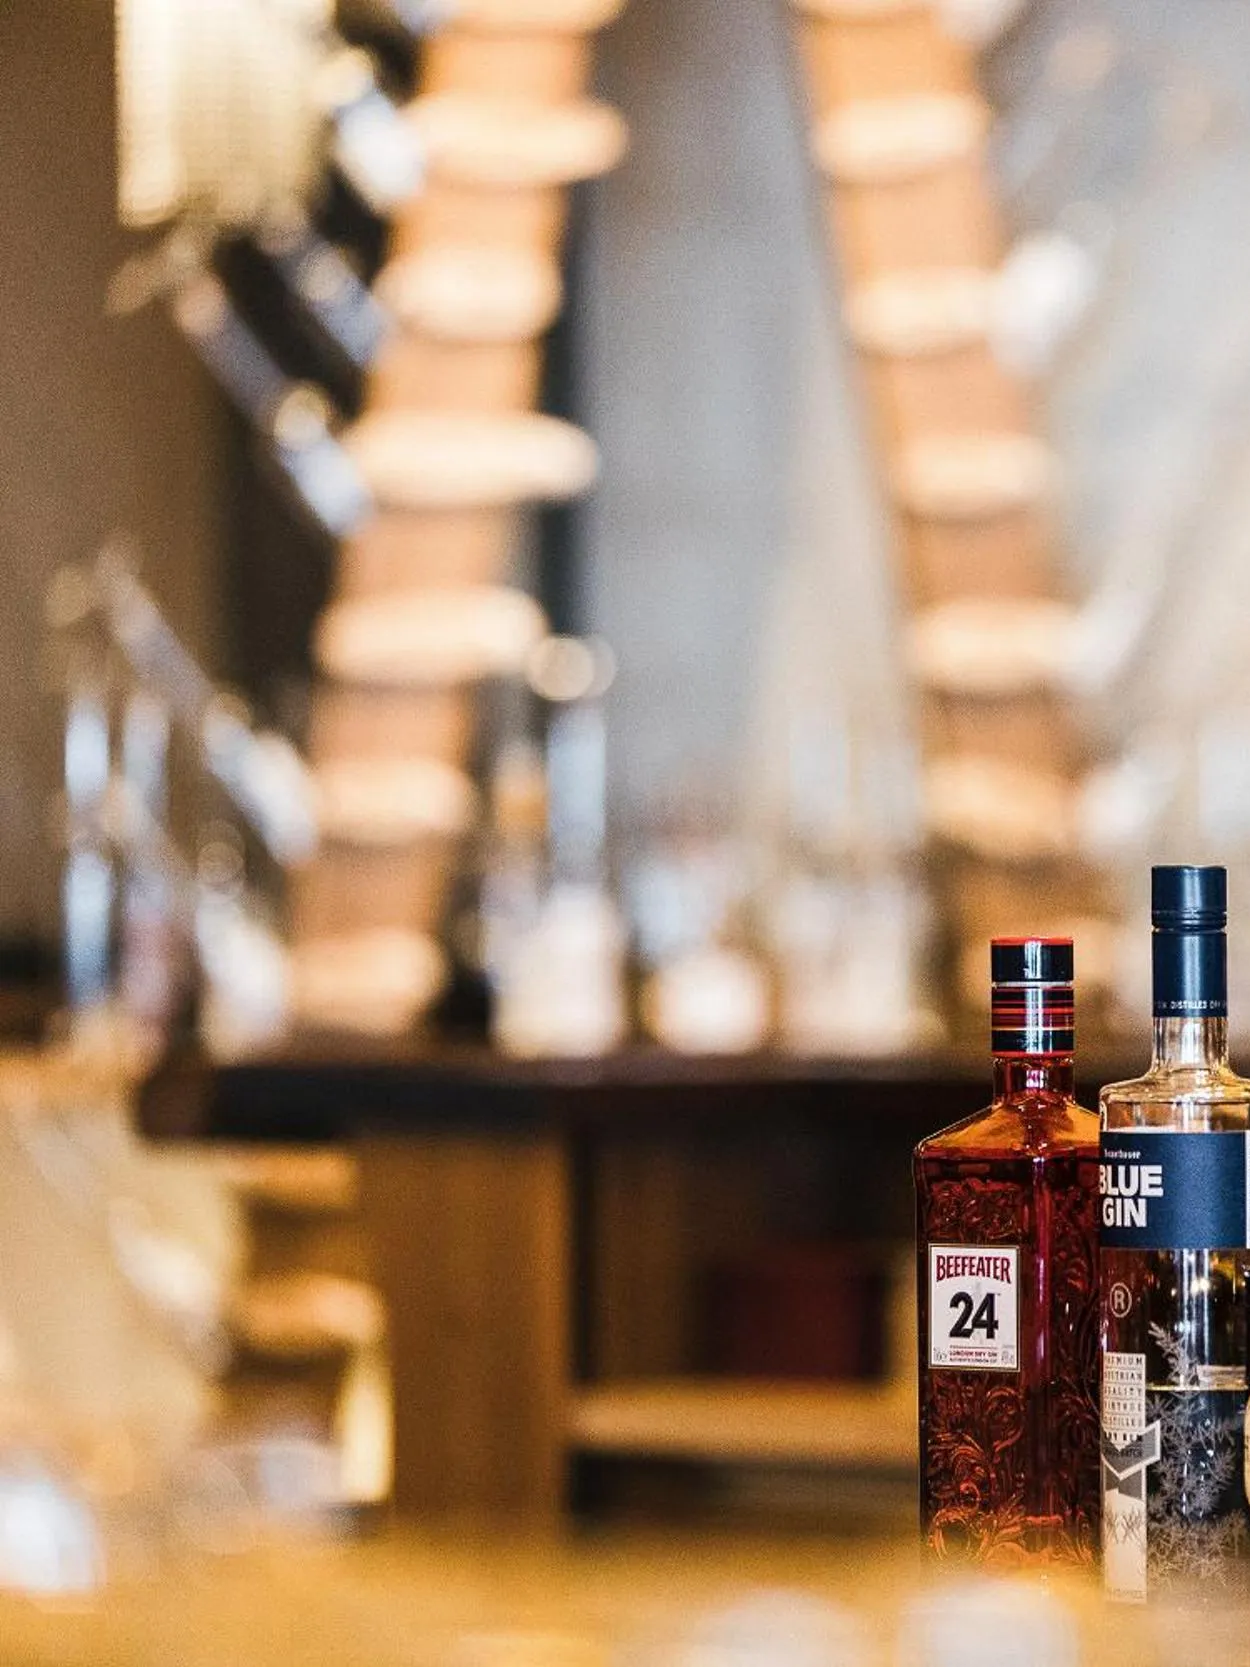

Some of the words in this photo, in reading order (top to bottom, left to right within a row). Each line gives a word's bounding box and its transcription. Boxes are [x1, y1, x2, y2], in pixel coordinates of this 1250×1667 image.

[1102, 1198, 1147, 1228] GIN
[936, 1255, 1011, 1284] BEEFEATER
[949, 1291, 999, 1339] 24
